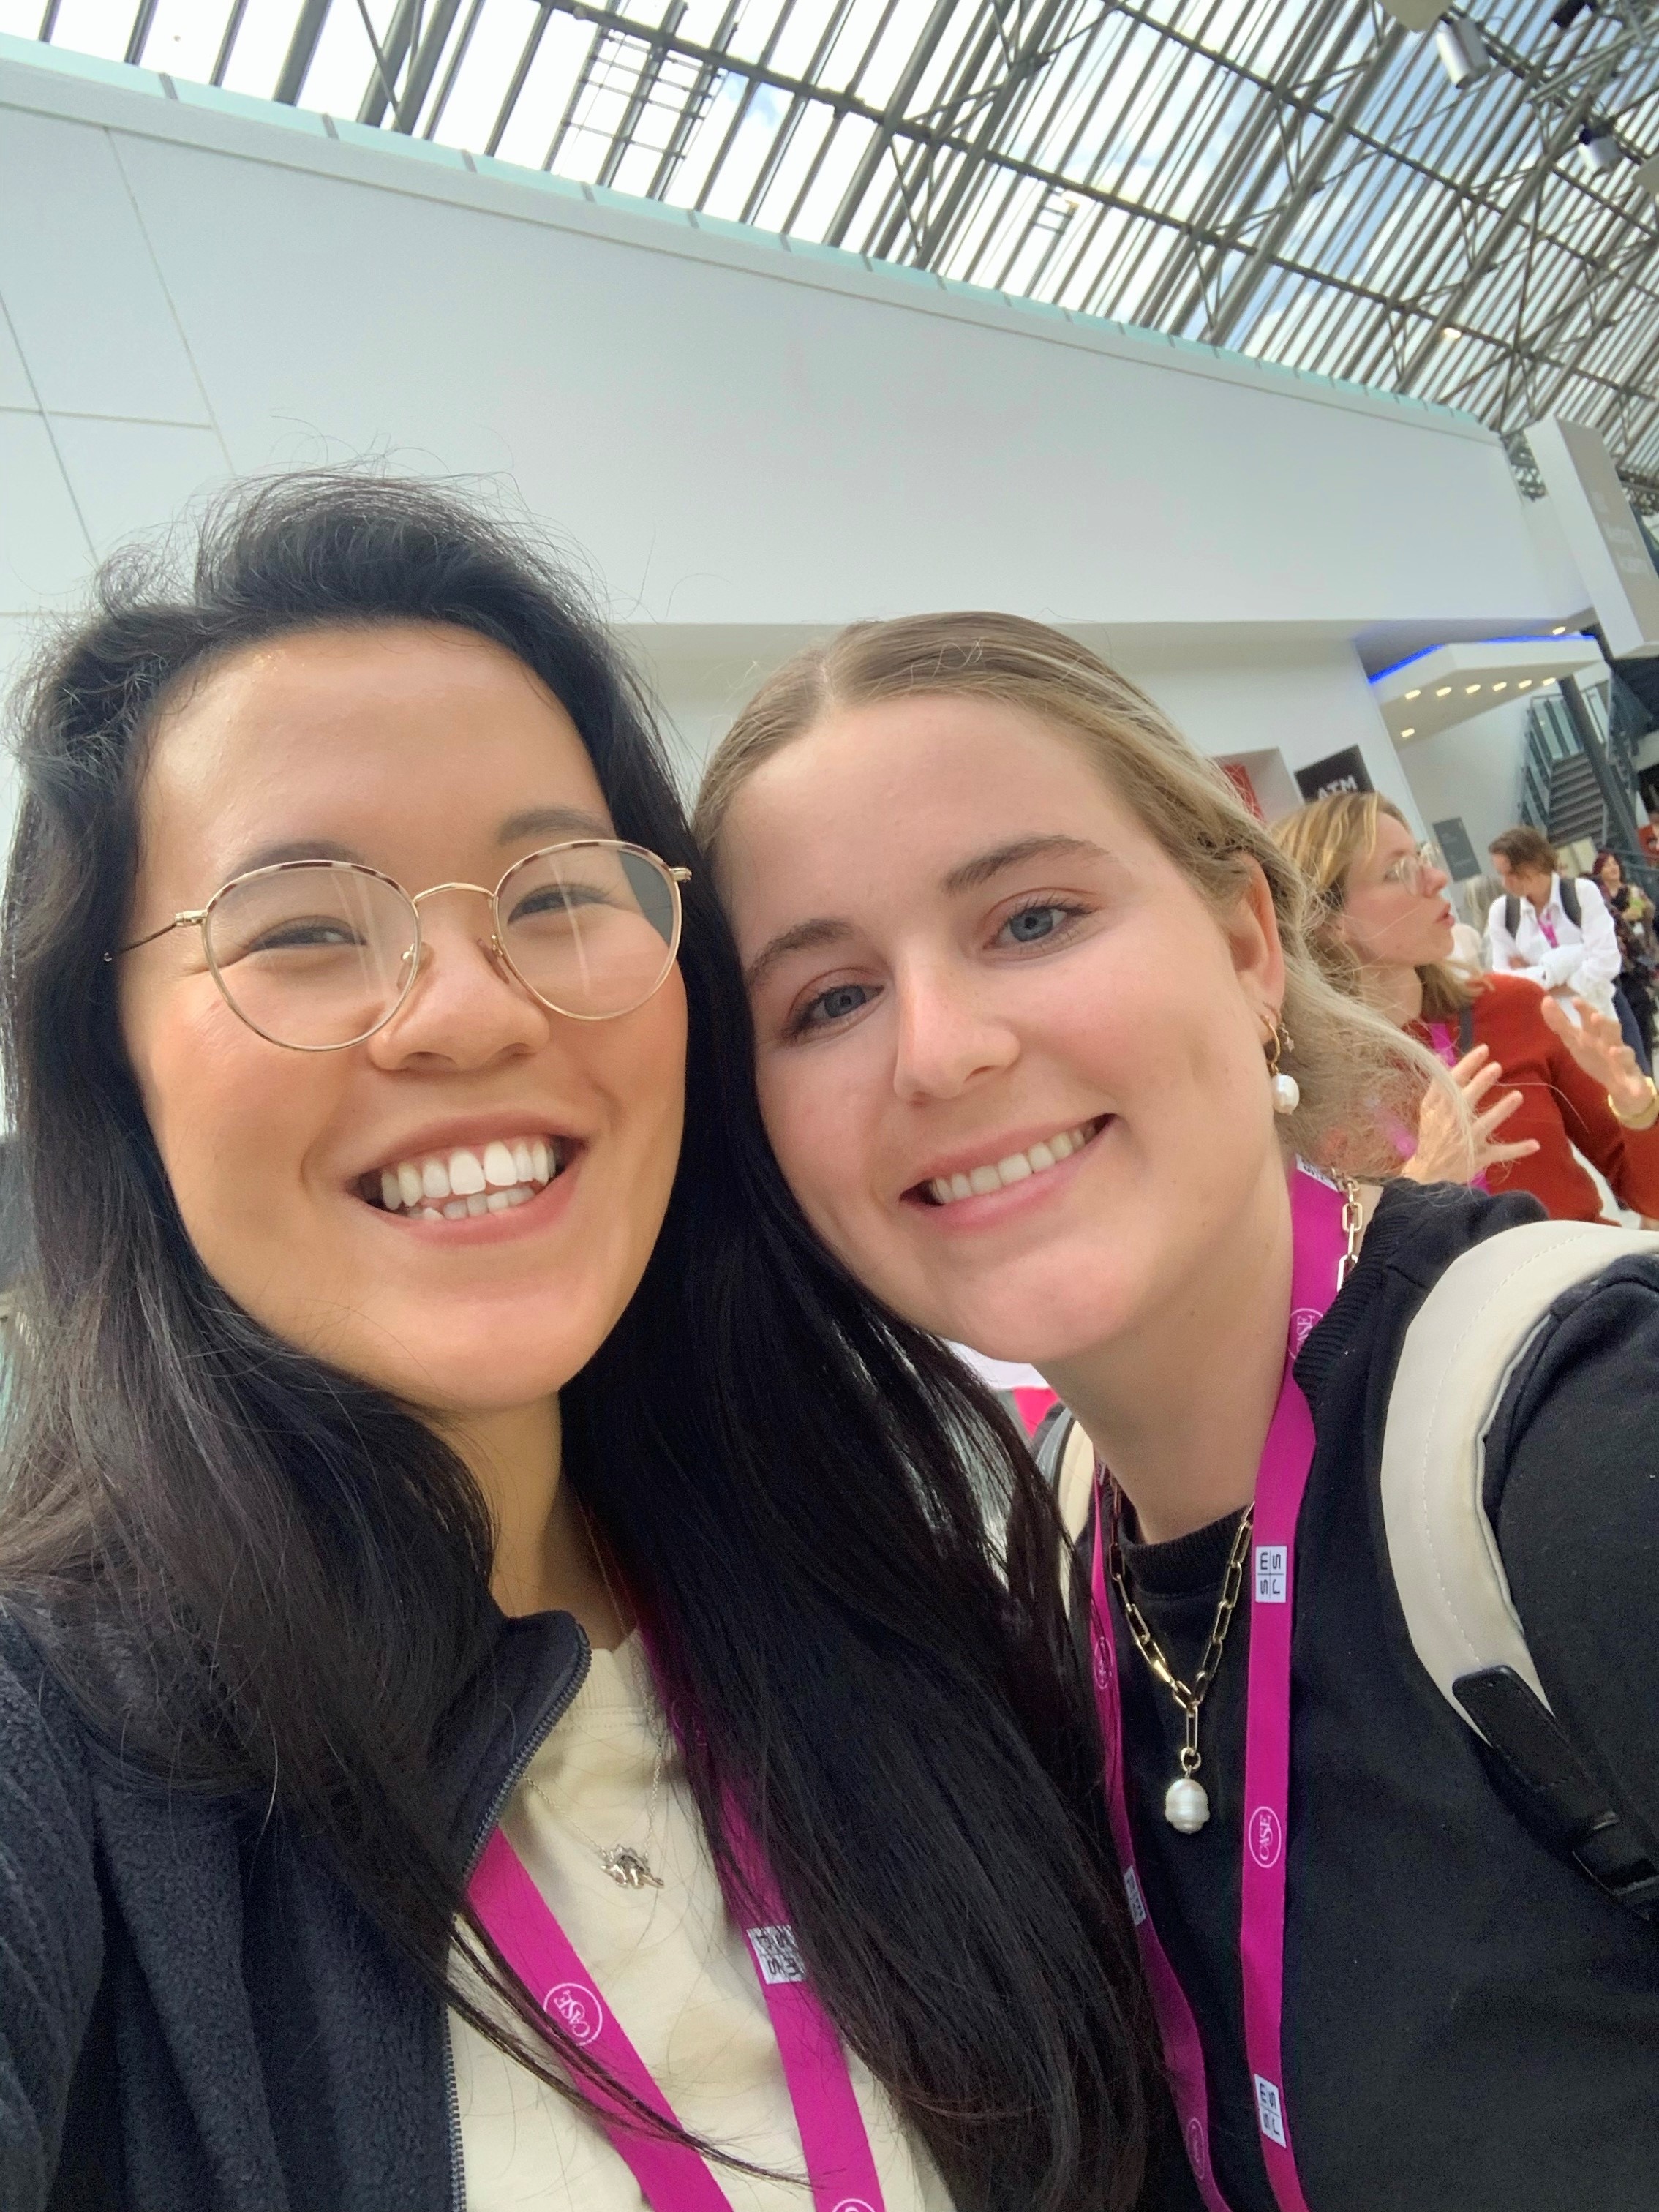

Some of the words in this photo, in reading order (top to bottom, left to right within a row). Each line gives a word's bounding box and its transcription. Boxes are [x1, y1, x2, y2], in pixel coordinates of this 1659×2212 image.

[1318, 775, 1358, 800] ATM
[1259, 1814, 1273, 1861] CASE
[554, 1990, 590, 2038] CASE
